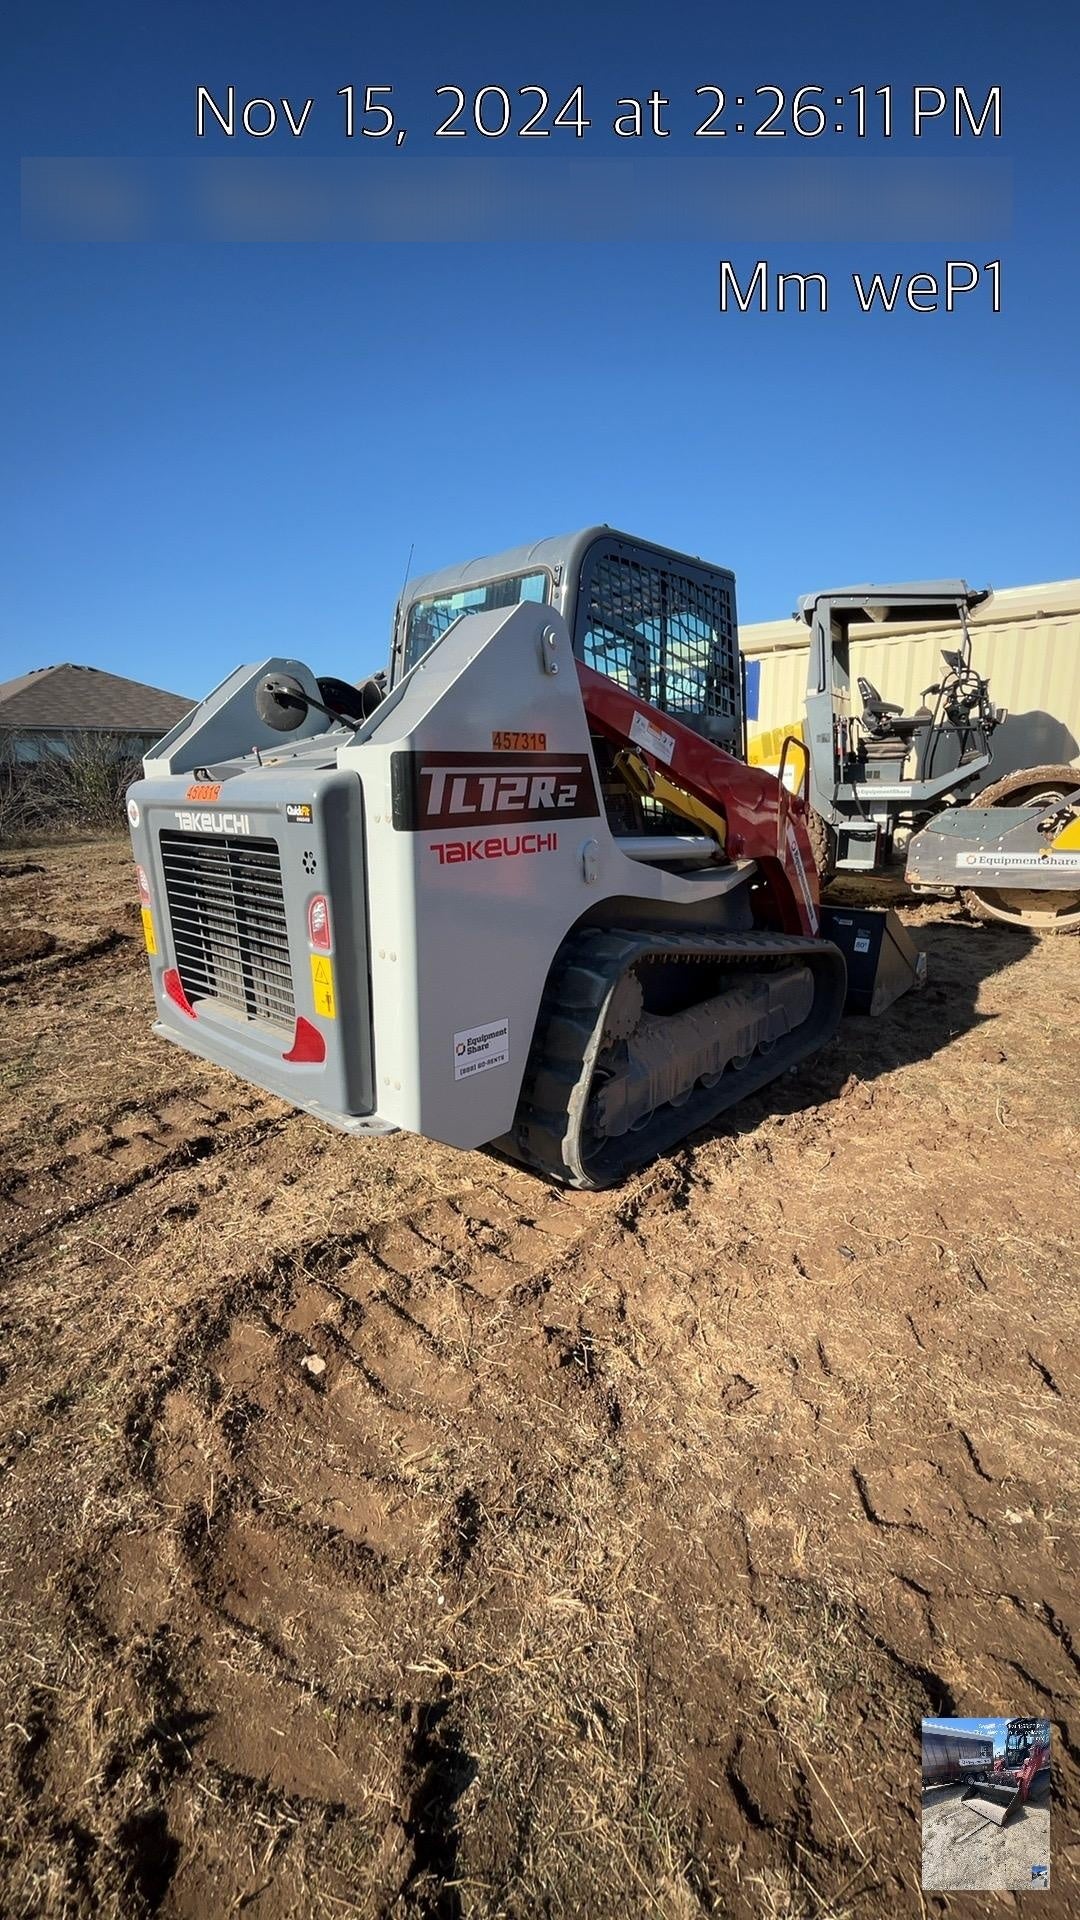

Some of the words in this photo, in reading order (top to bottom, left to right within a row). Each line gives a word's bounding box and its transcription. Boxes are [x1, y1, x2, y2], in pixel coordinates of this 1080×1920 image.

[493, 731, 546, 751] 457319
[186, 785, 221, 800] 457319
[420, 766, 582, 816] TL12R2
[174, 811, 250, 834] TAKEUCHI
[430, 832, 557, 864] TAKEUCHI
[979, 855, 1078, 866] EquipmentShare
[467, 1027, 507, 1046] Equipment
[467, 1042, 490, 1055] Share
